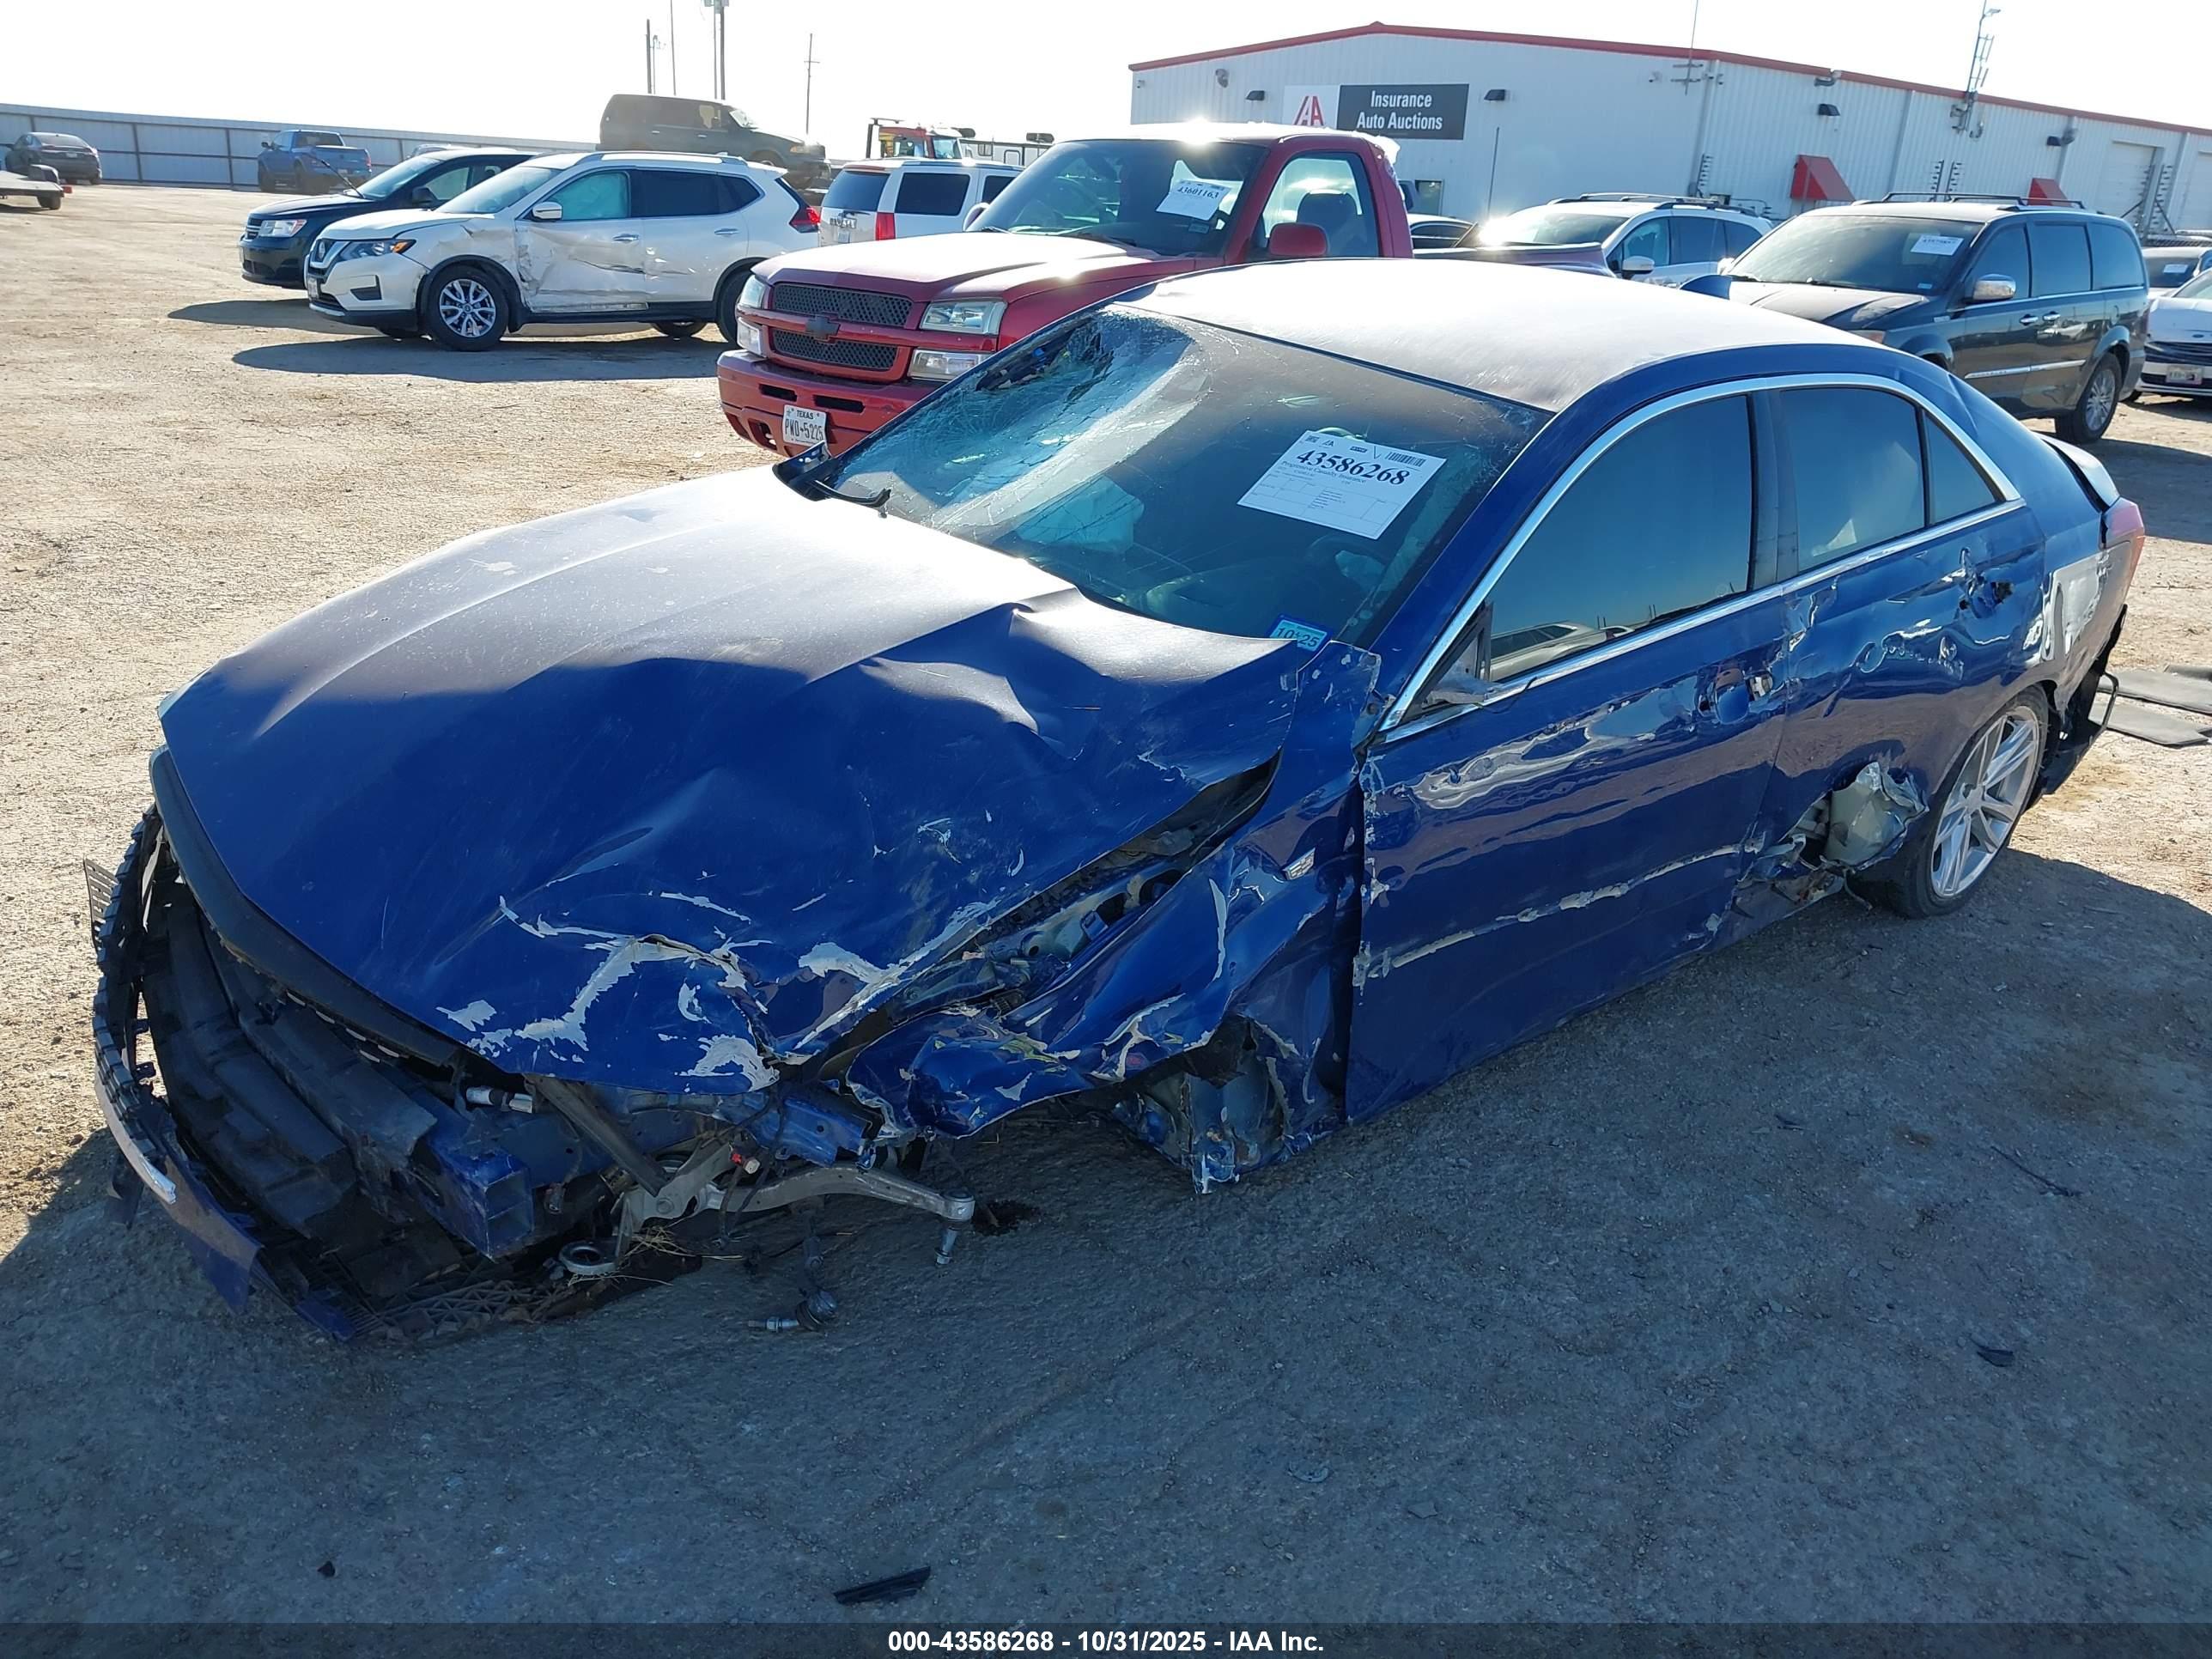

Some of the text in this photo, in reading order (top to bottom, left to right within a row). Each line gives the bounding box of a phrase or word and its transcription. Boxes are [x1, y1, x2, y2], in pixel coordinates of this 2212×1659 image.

[1370, 90, 1431, 108] Insurance
[1356, 112, 1443, 131] Auto Auctions
[797, 410, 814, 419] TEXAS
[1297, 449, 1410, 485] 43586268
[1298, 634, 1319, 647] 25
